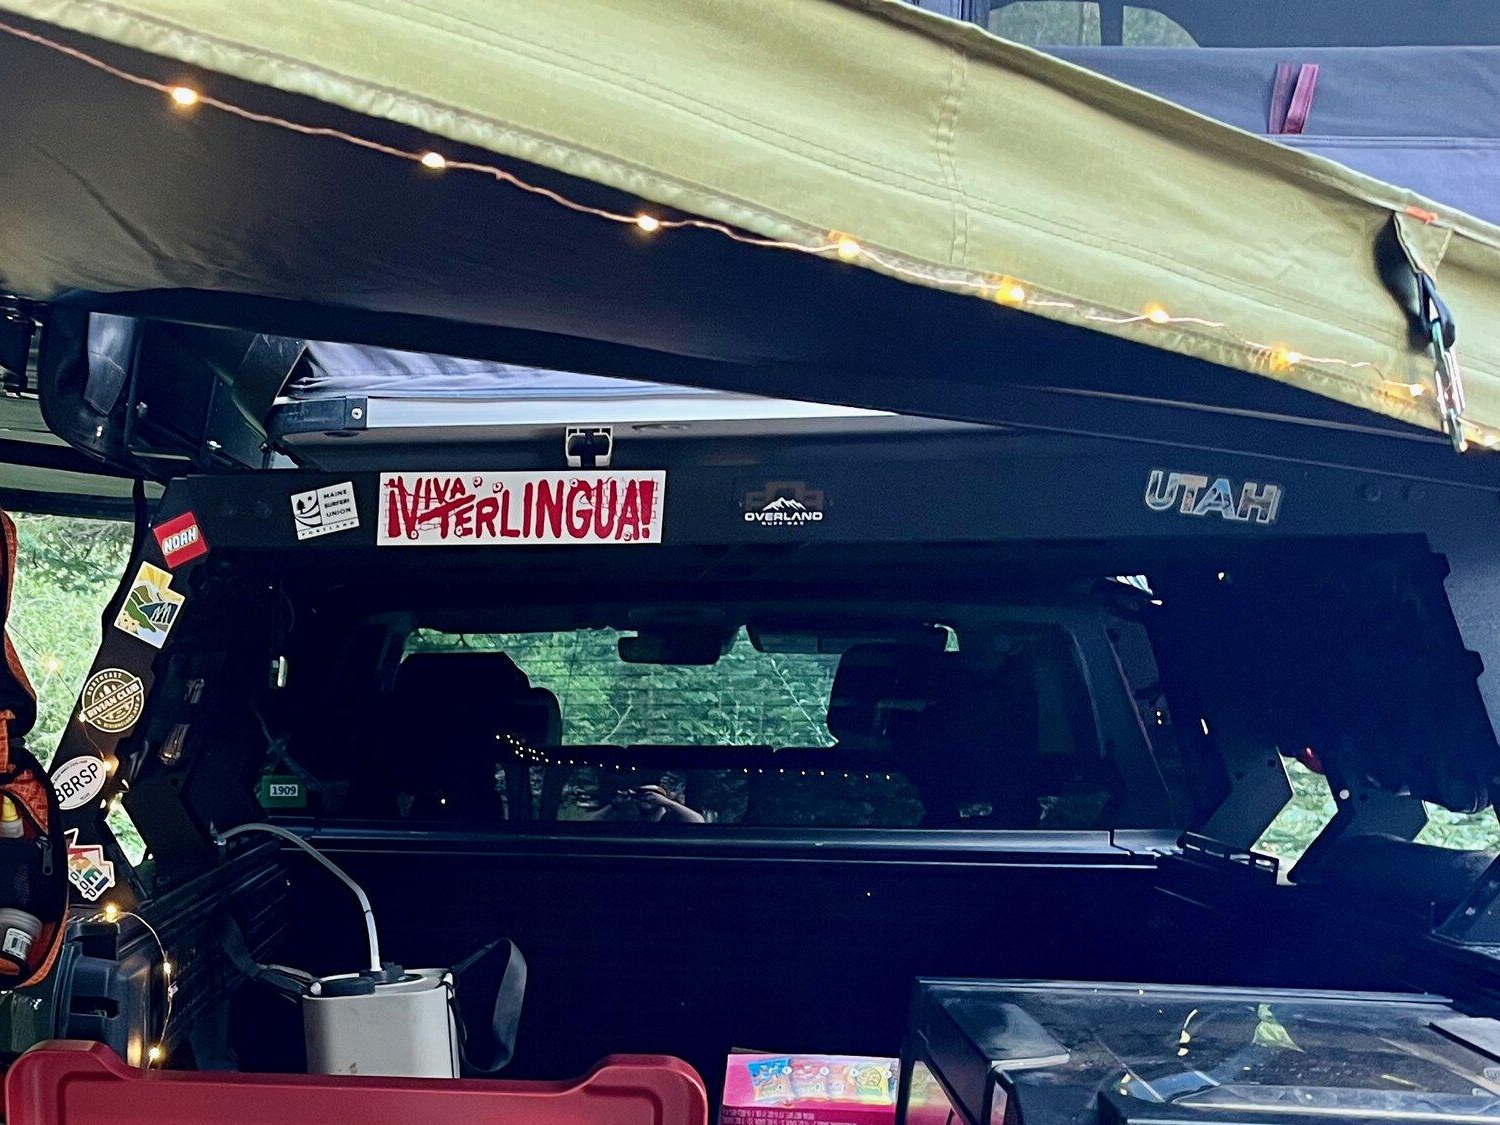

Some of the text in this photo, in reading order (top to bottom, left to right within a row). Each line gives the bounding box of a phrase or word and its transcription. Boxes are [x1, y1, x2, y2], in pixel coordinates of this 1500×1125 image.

[323, 489, 347, 500] MAINE
[1144, 469, 1281, 523] UTAH
[326, 507, 351, 518] UNION
[744, 511, 823, 521] OVERLAND
[162, 525, 199, 556] NOAH
[87, 696, 117, 718] RIVIAN
[116, 683, 140, 700] CLUB
[54, 762, 99, 803] BBRSP
[272, 786, 296, 795] 1909
